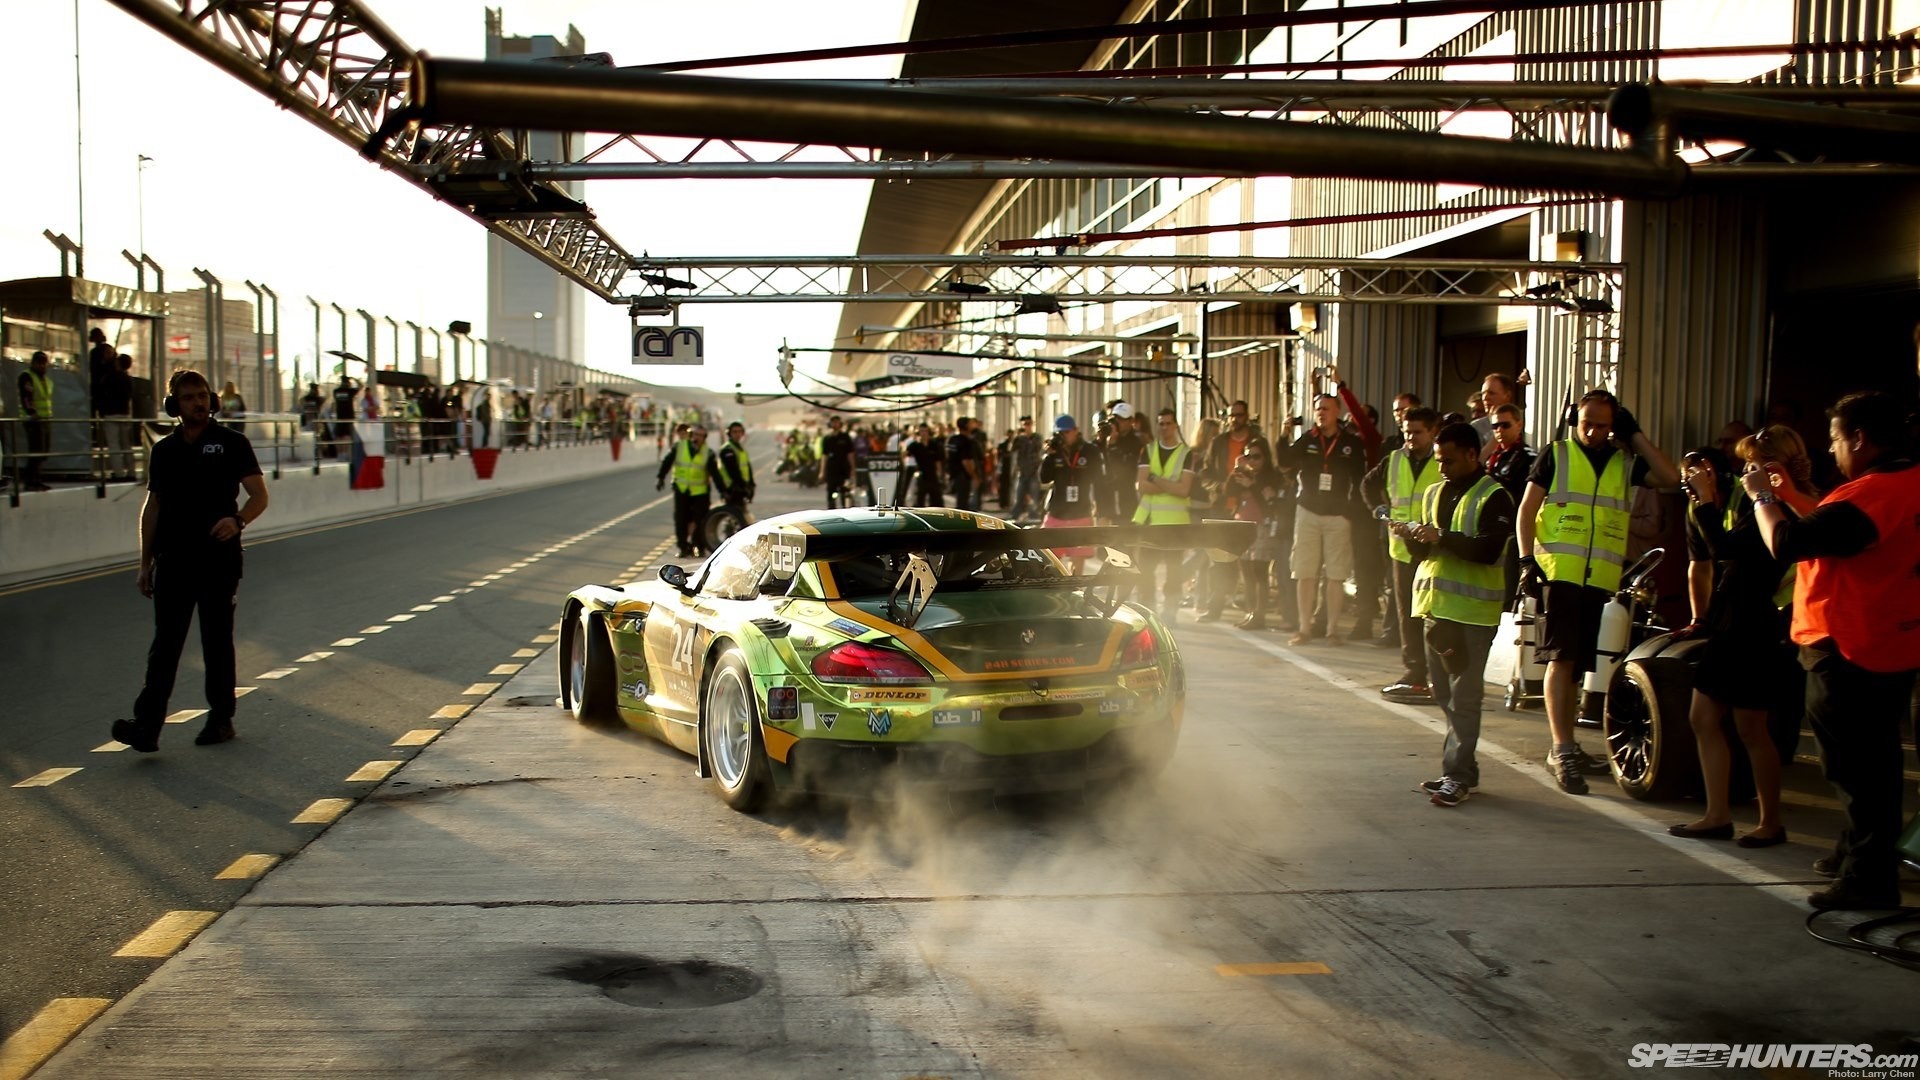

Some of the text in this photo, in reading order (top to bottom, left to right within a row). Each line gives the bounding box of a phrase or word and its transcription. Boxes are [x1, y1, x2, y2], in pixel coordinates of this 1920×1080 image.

[633, 327, 703, 357] ram
[888, 354, 921, 368] GDL
[202, 444, 224, 454] ram
[868, 461, 900, 470] STOP
[1010, 549, 1043, 562] 24
[671, 624, 694, 676] 24
[863, 691, 927, 699] DUNLOP
